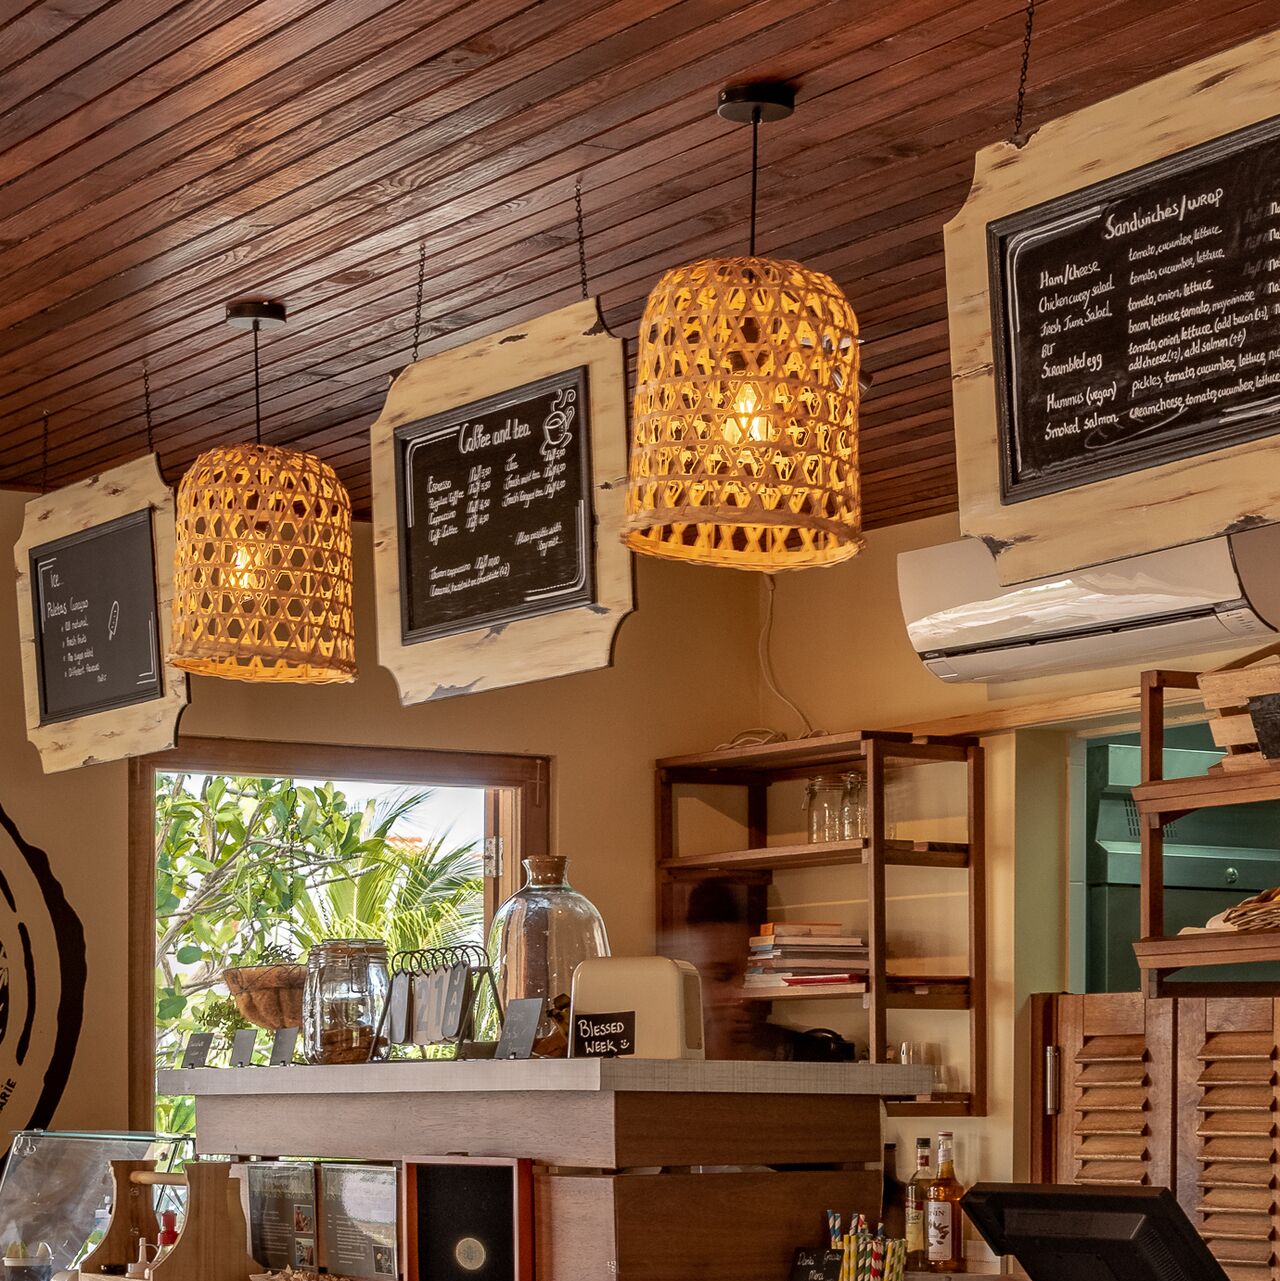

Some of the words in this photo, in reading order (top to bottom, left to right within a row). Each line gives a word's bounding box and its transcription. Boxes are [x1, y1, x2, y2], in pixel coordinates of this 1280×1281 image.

[1183, 279, 1214, 296] lettuce
[1184, 339, 1201, 358] add
[1086, 353, 1103, 372] egg
[1086, 380, 1117, 407] (vegan)
[459, 422, 492, 454] Coffee
[492, 418, 511, 445] and
[513, 418, 532, 440] tea
[1044, 416, 1081, 441] Smoked
[584, 1039, 619, 1054] WEEK
